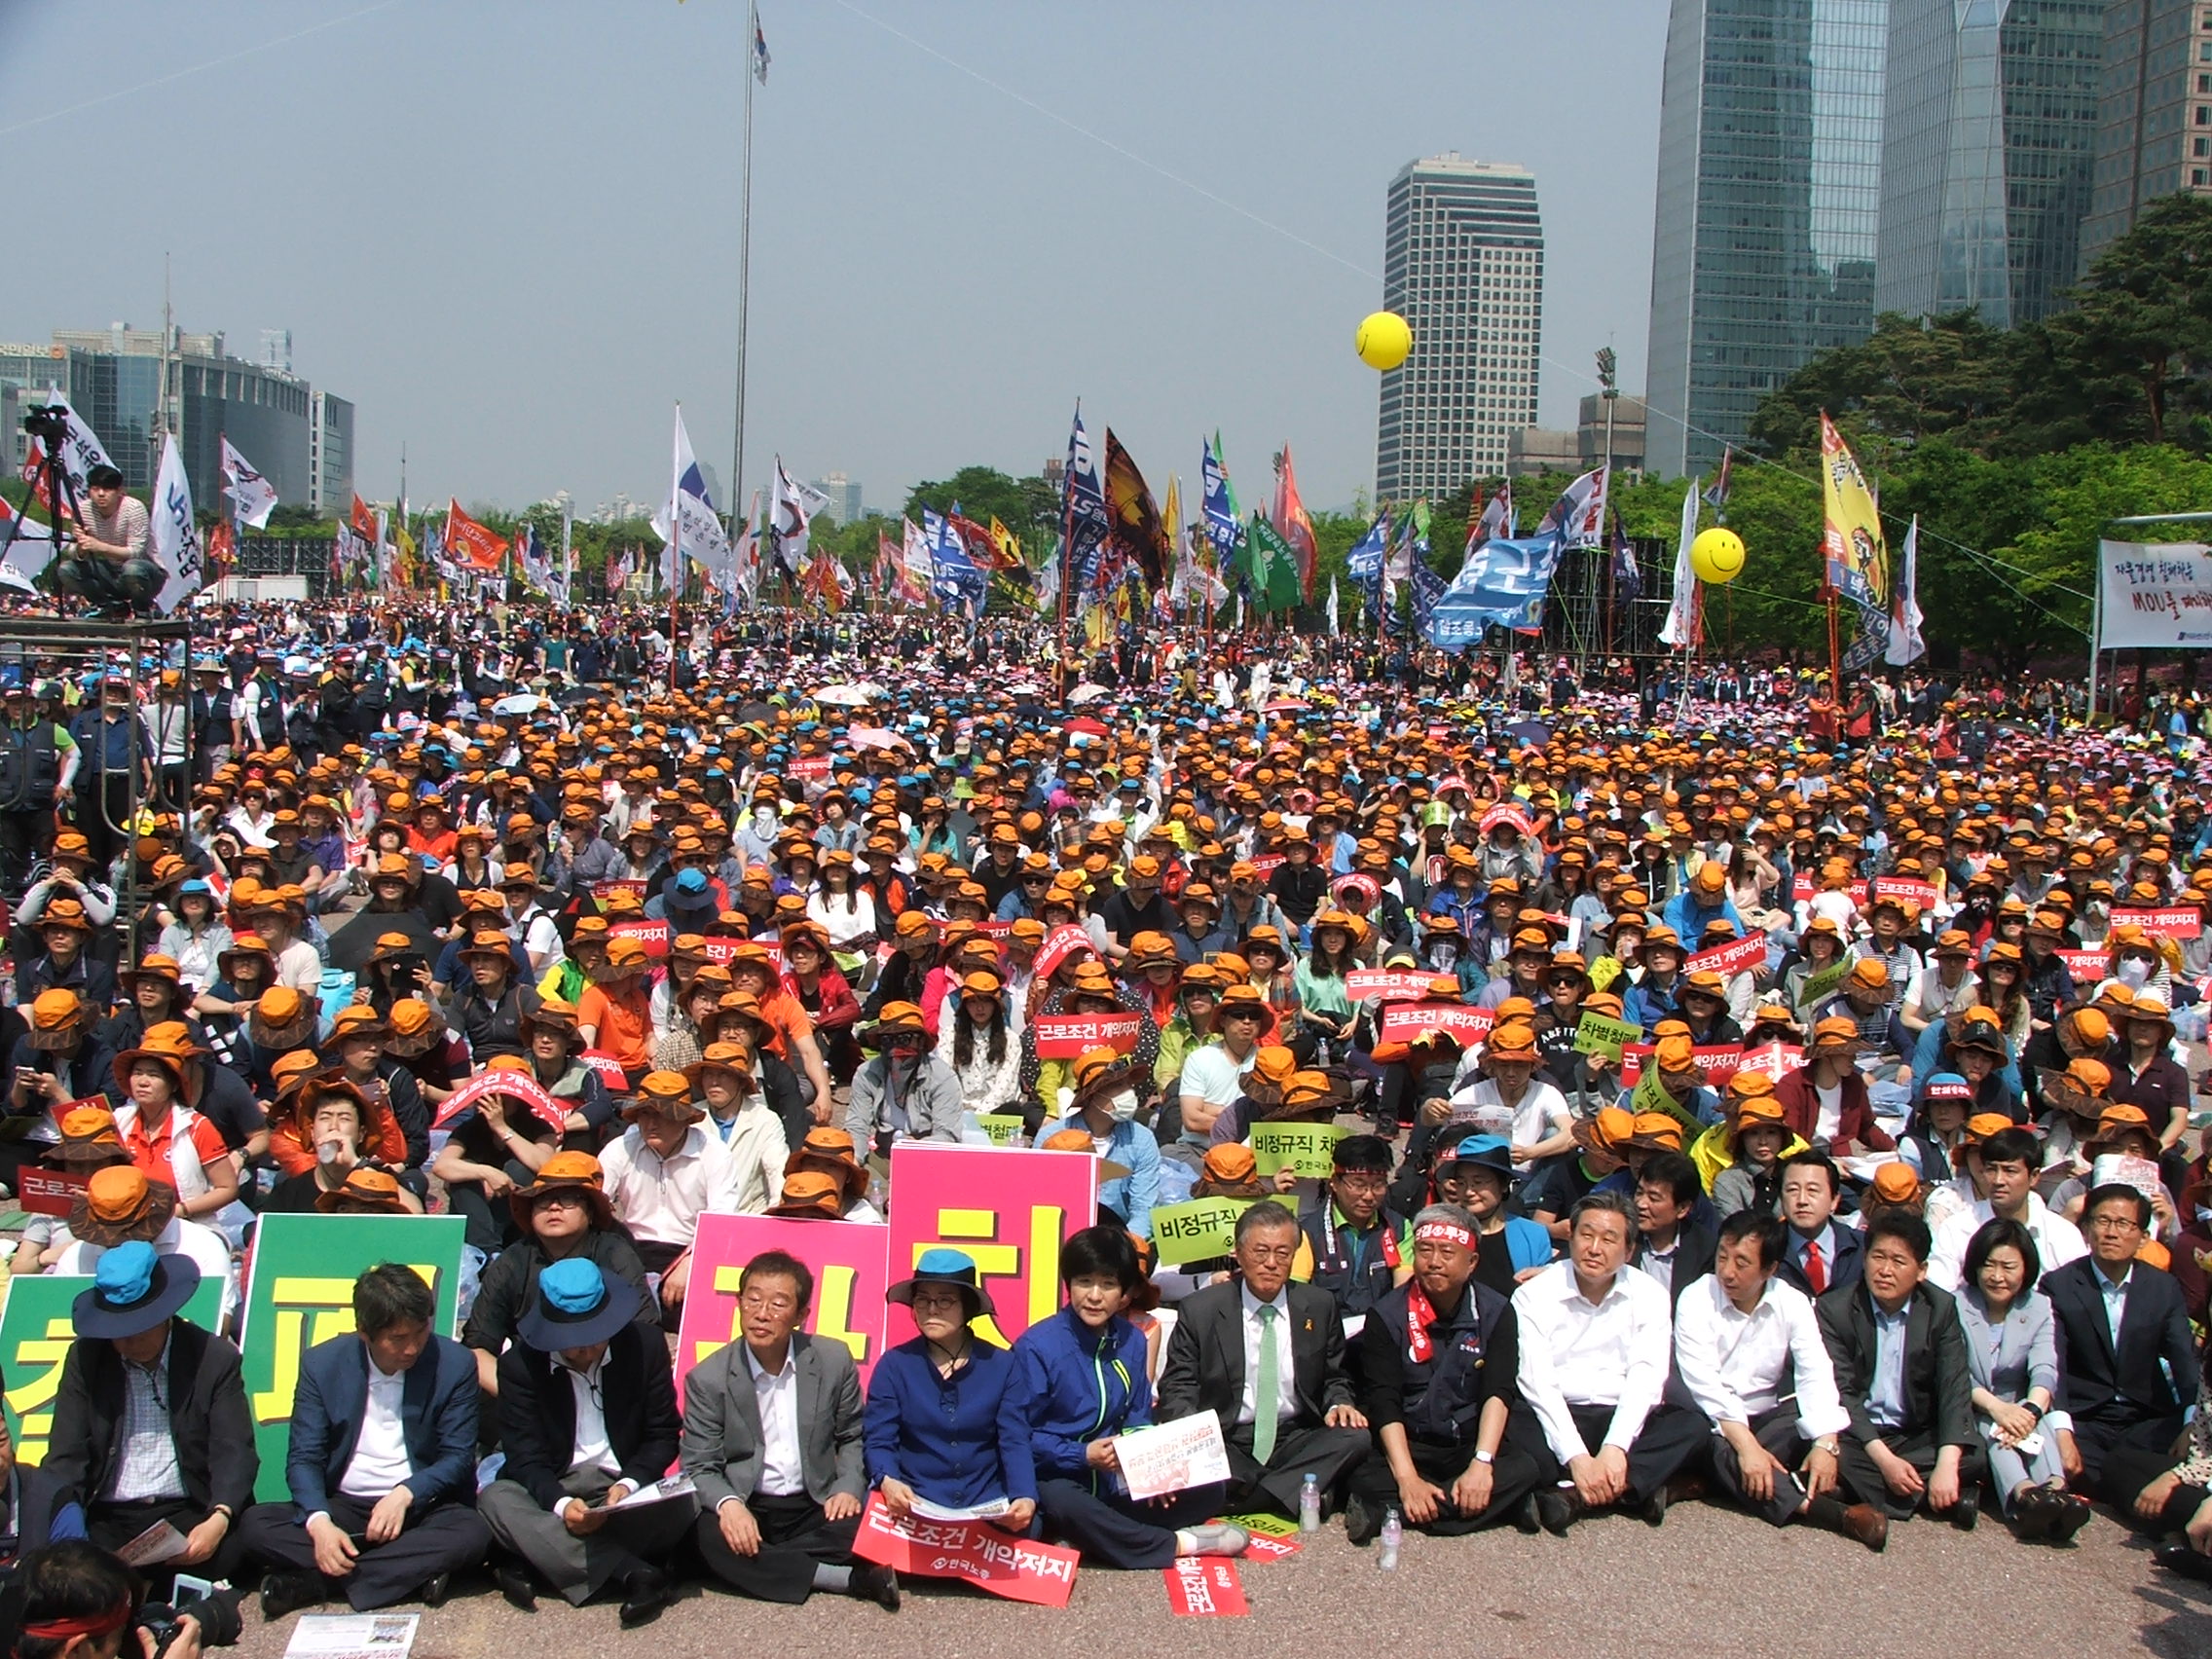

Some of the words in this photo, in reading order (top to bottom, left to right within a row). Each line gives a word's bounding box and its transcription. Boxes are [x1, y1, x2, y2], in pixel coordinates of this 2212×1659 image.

[2131, 590, 2181, 621] MOU를
[2111, 914, 2153, 926] 근로조건
[2154, 913, 2197, 926] 개악저지
[1723, 936, 1764, 964] 개악저지
[1347, 975, 1401, 987] 근로조건
[1038, 1021, 1097, 1041] 근로조건
[1100, 1020, 1140, 1039] 개악저지
[1384, 1011, 1436, 1027] 근로조건
[1439, 1011, 1493, 1031] 개악저지
[1581, 1020, 1638, 1046] 차별철폐
[1255, 1135, 1312, 1154] 비정규직
[1320, 1135, 1340, 1153] 차
[1160, 1207, 1237, 1239] 비정규직
[1446, 1226, 1470, 1245] 투쟁
[868, 1502, 969, 1549] 근로조건
[973, 1533, 1073, 1583] 개악저지
[947, 1557, 990, 1580] 한국노총
[1175, 1556, 1204, 1579] 개악
